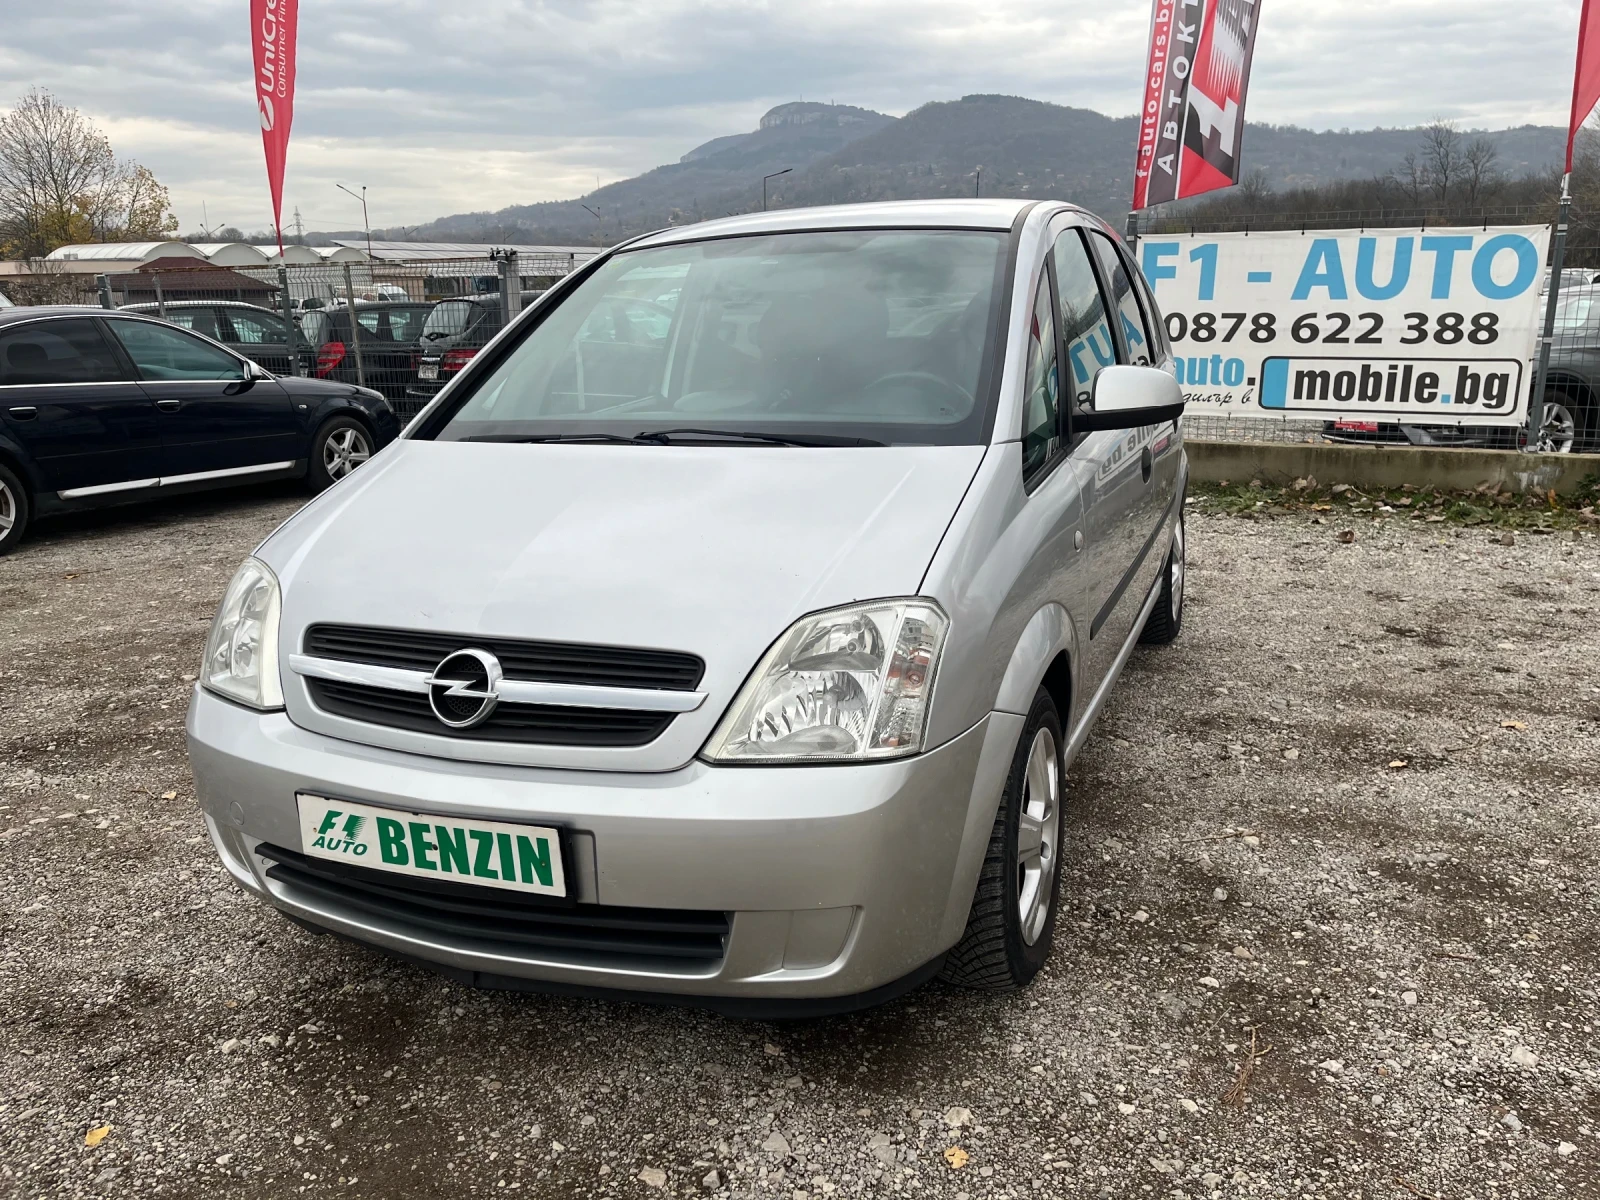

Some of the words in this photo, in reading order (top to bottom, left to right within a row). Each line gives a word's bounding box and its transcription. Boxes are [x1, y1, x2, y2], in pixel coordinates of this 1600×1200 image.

[278, 0, 286, 22] Fin
[277, 24, 286, 98] Consumer
[1143, 242, 1218, 301] F1
[1291, 234, 1539, 300] AUTO
[1168, 311, 1277, 344] 0878
[1290, 311, 1383, 344] 622
[1400, 311, 1500, 345] 388
[1294, 364, 1510, 409] mobile.bg
[311, 835, 368, 856] AUTO
[376, 816, 555, 887] BENZIN
